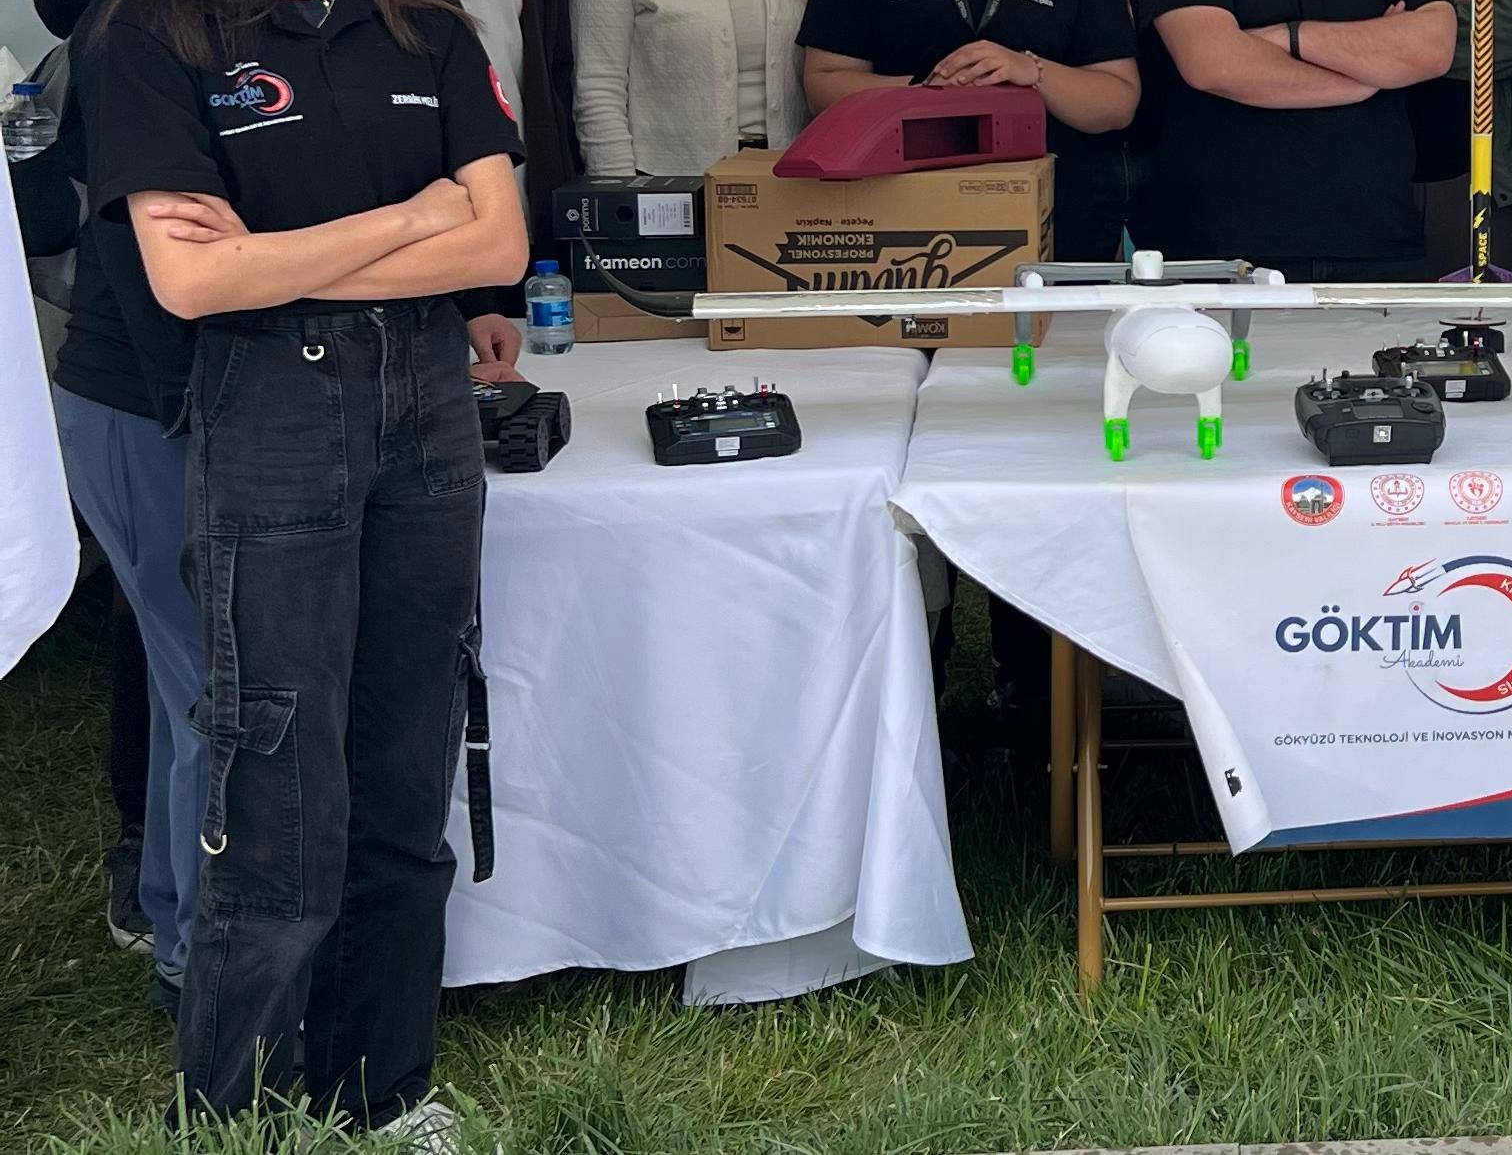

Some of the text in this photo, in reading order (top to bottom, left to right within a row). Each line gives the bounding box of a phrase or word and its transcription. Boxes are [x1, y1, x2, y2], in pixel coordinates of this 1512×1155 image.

[795, 218, 833, 227] Napkin
[787, 248, 874, 259] PROFESYONEL
[1478, 232, 1488, 267] SPACE
[1275, 602, 1462, 653] GÖKTİM
[1379, 649, 1465, 669] Akademi
[1274, 732, 1336, 746] GÖKYÜZÜ
[1339, 731, 1409, 744] TEKNOLOJİ
[1412, 732, 1428, 742] VE
[1432, 730, 1504, 742] İNOVASYON
